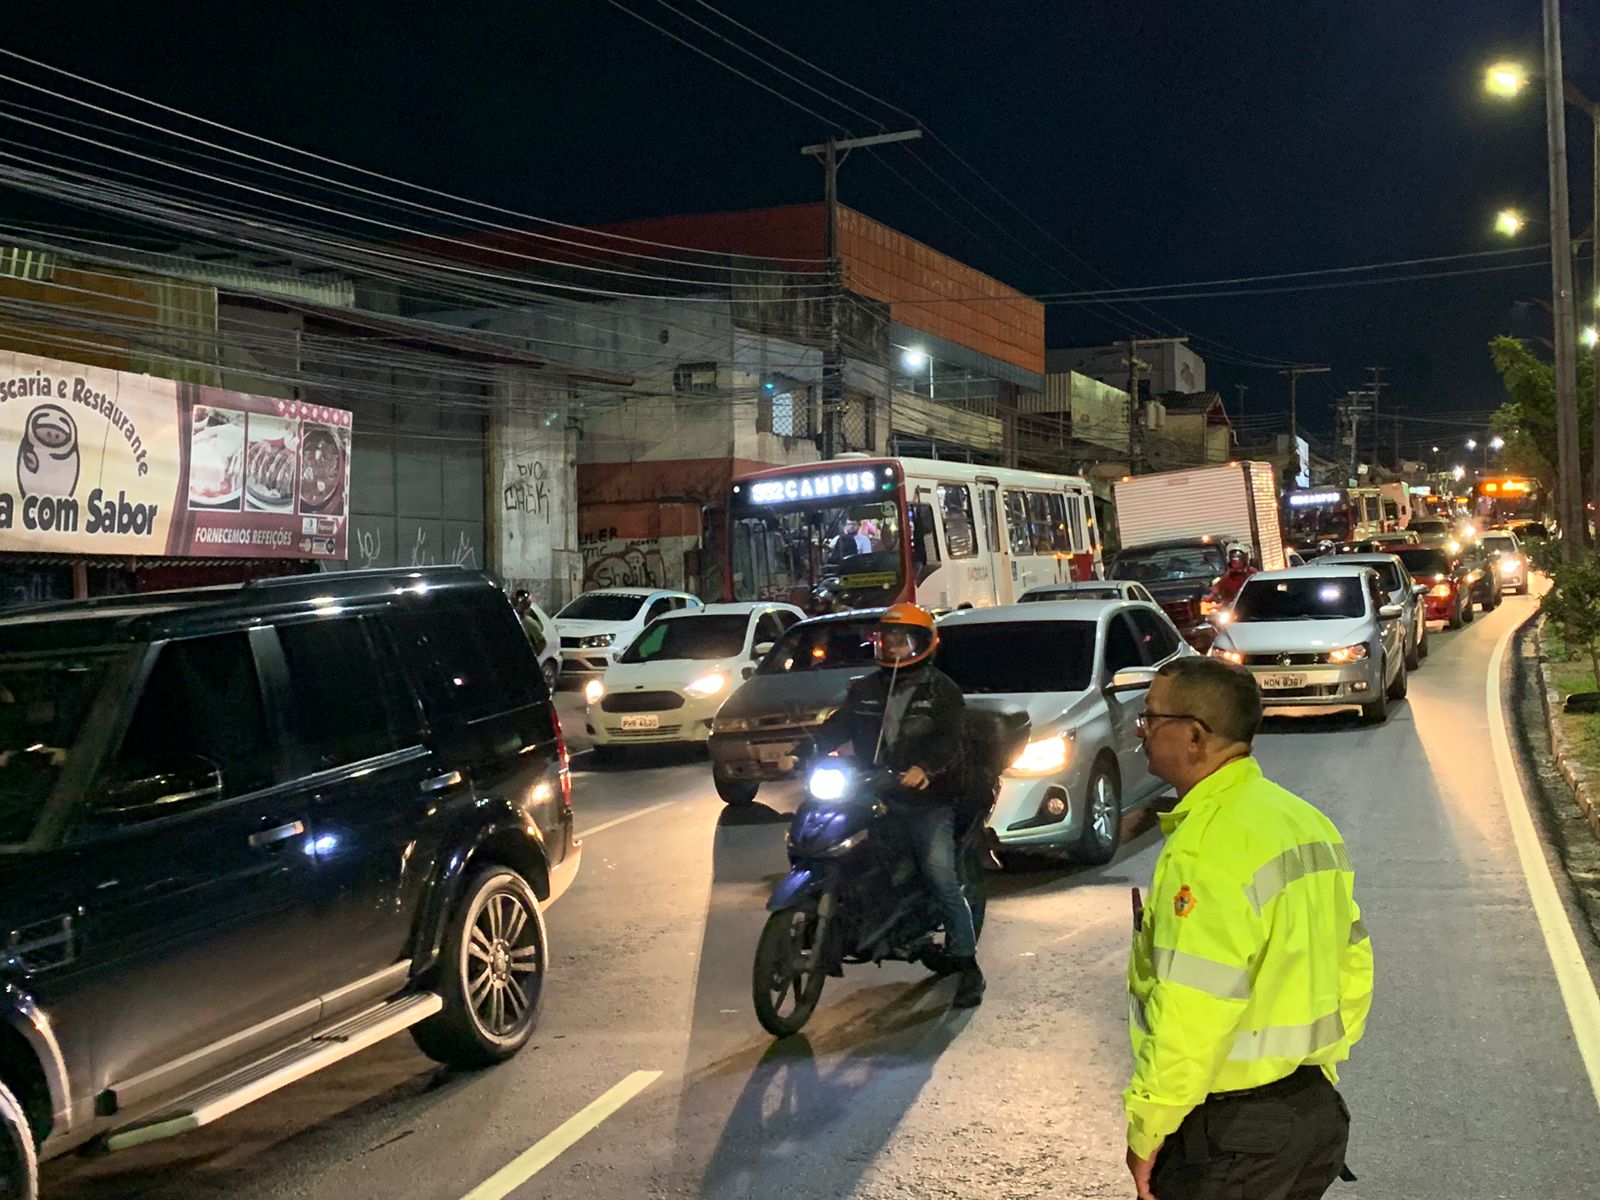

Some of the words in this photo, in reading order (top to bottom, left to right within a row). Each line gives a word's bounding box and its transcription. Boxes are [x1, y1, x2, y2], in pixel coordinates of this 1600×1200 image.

[57, 380, 68, 399] e
[72, 377, 149, 477] Restaurante
[785, 471, 875, 499] CAMPUS
[22, 495, 79, 531] com
[85, 488, 158, 535] Sabor
[195, 527, 251, 544] FORNECEMOS
[251, 527, 293, 549] REFEIÇÕES
